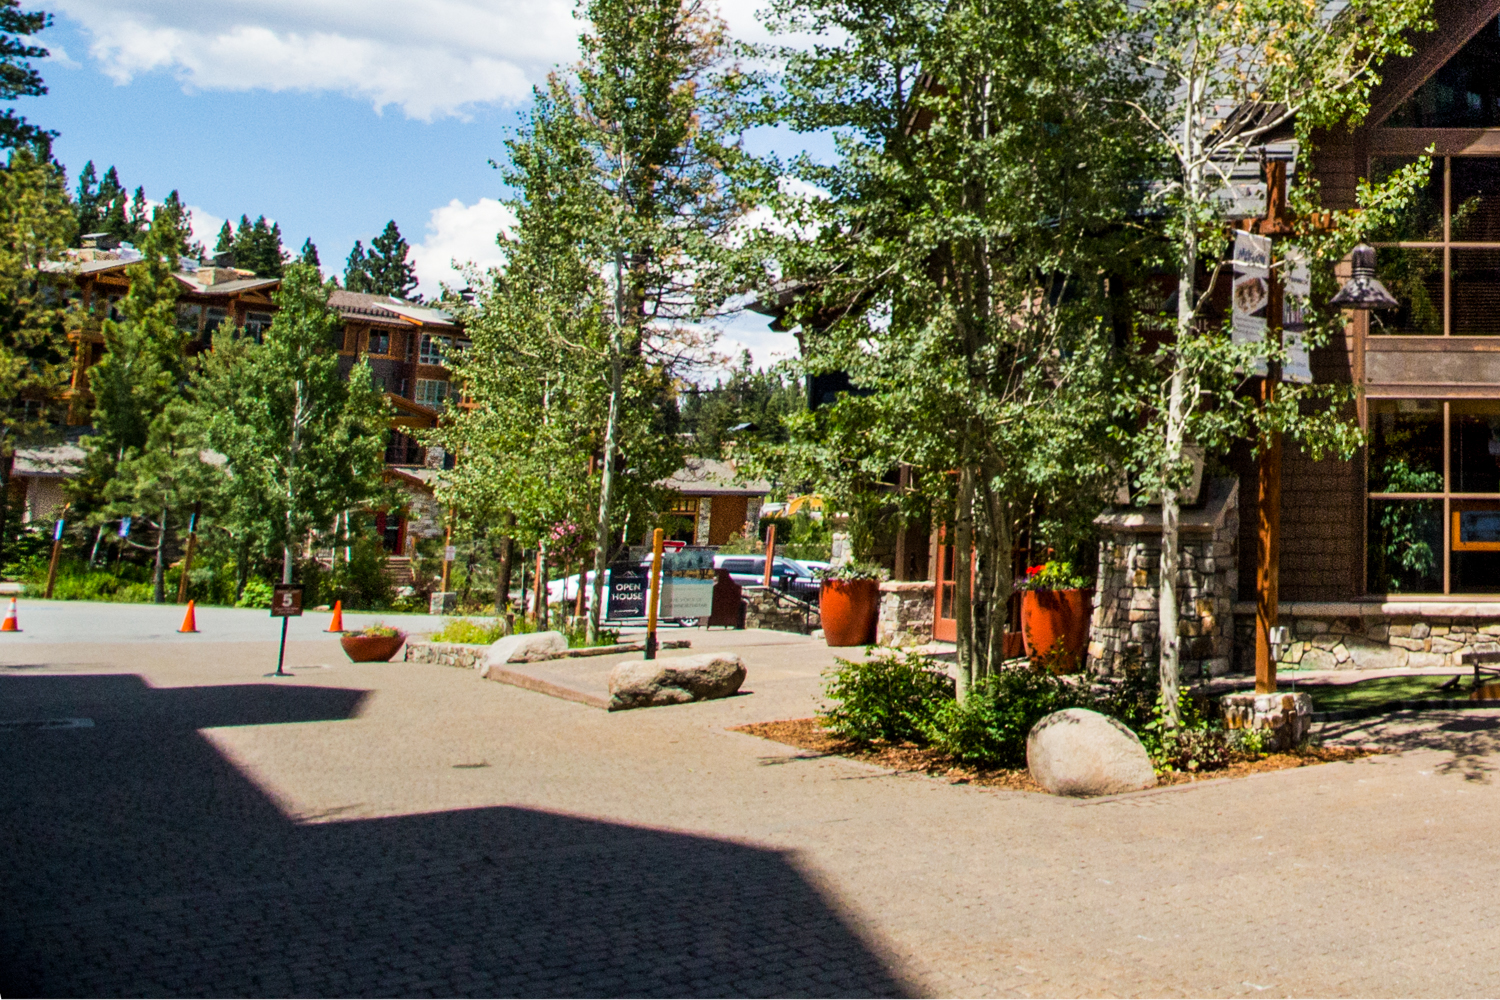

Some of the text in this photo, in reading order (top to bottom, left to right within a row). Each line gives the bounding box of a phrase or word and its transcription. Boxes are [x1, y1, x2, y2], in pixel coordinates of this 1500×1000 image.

[615, 583, 641, 592] OPEN
[282, 593, 293, 607] 5
[612, 592, 642, 601] HOUSE
